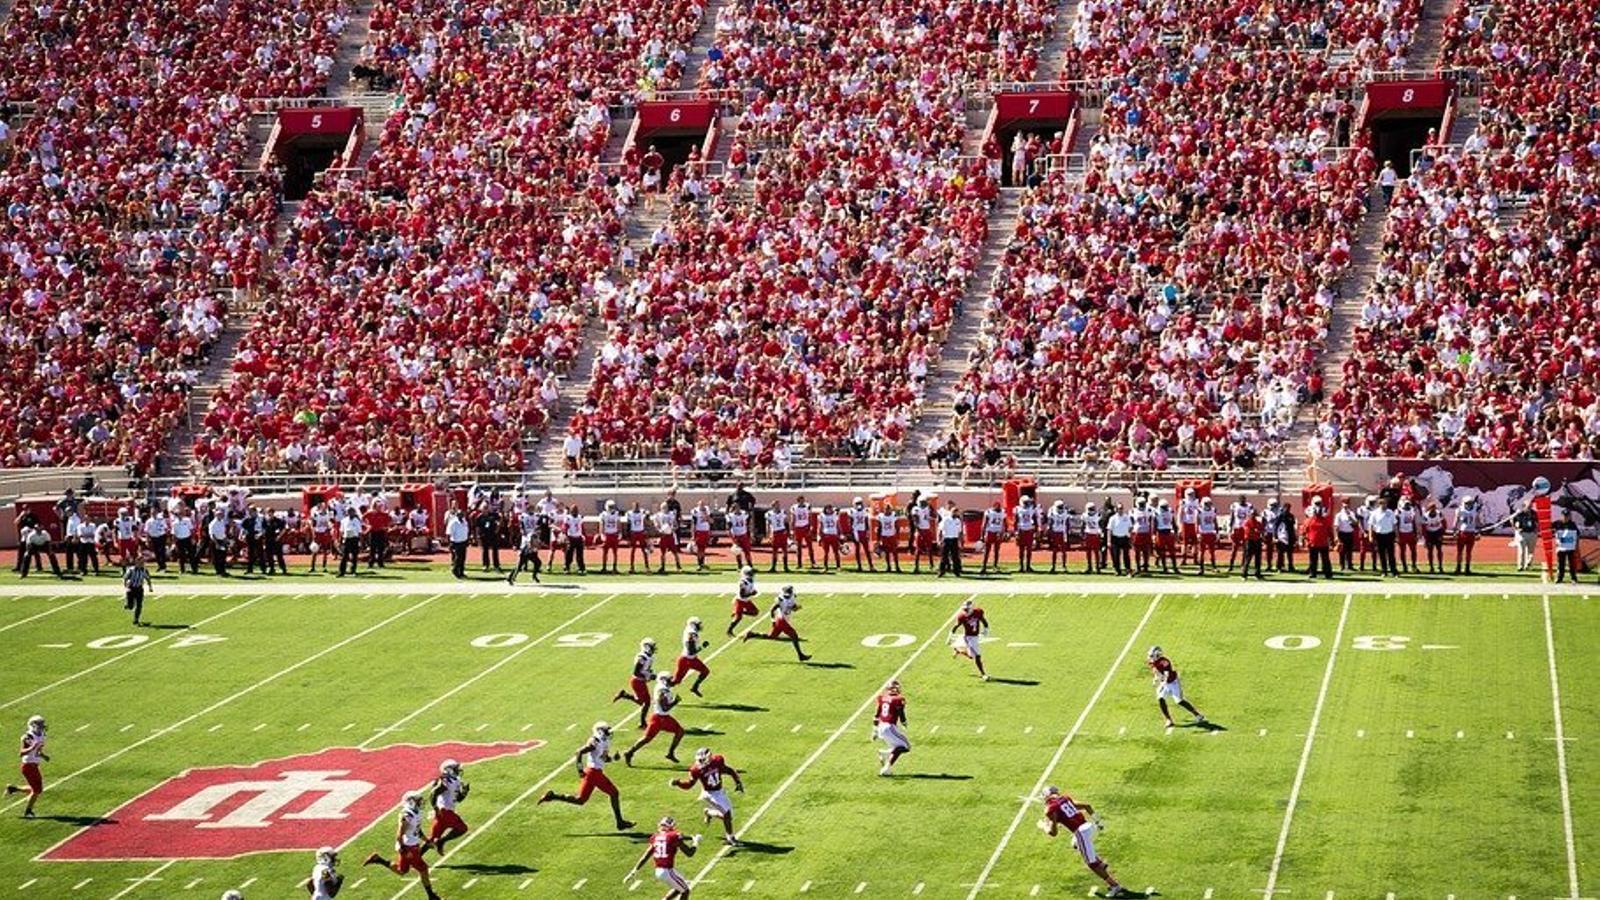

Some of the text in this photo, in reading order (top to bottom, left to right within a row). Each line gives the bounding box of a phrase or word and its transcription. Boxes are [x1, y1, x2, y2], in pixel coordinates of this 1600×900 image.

[1402, 89, 1414, 103] 8
[1029, 99, 1040, 114] 7
[311, 115, 322, 128] 5
[670, 108, 681, 122] 6
[881, 703, 890, 717] 8
[707, 772, 720, 786] 41
[654, 840, 669, 858] 31
